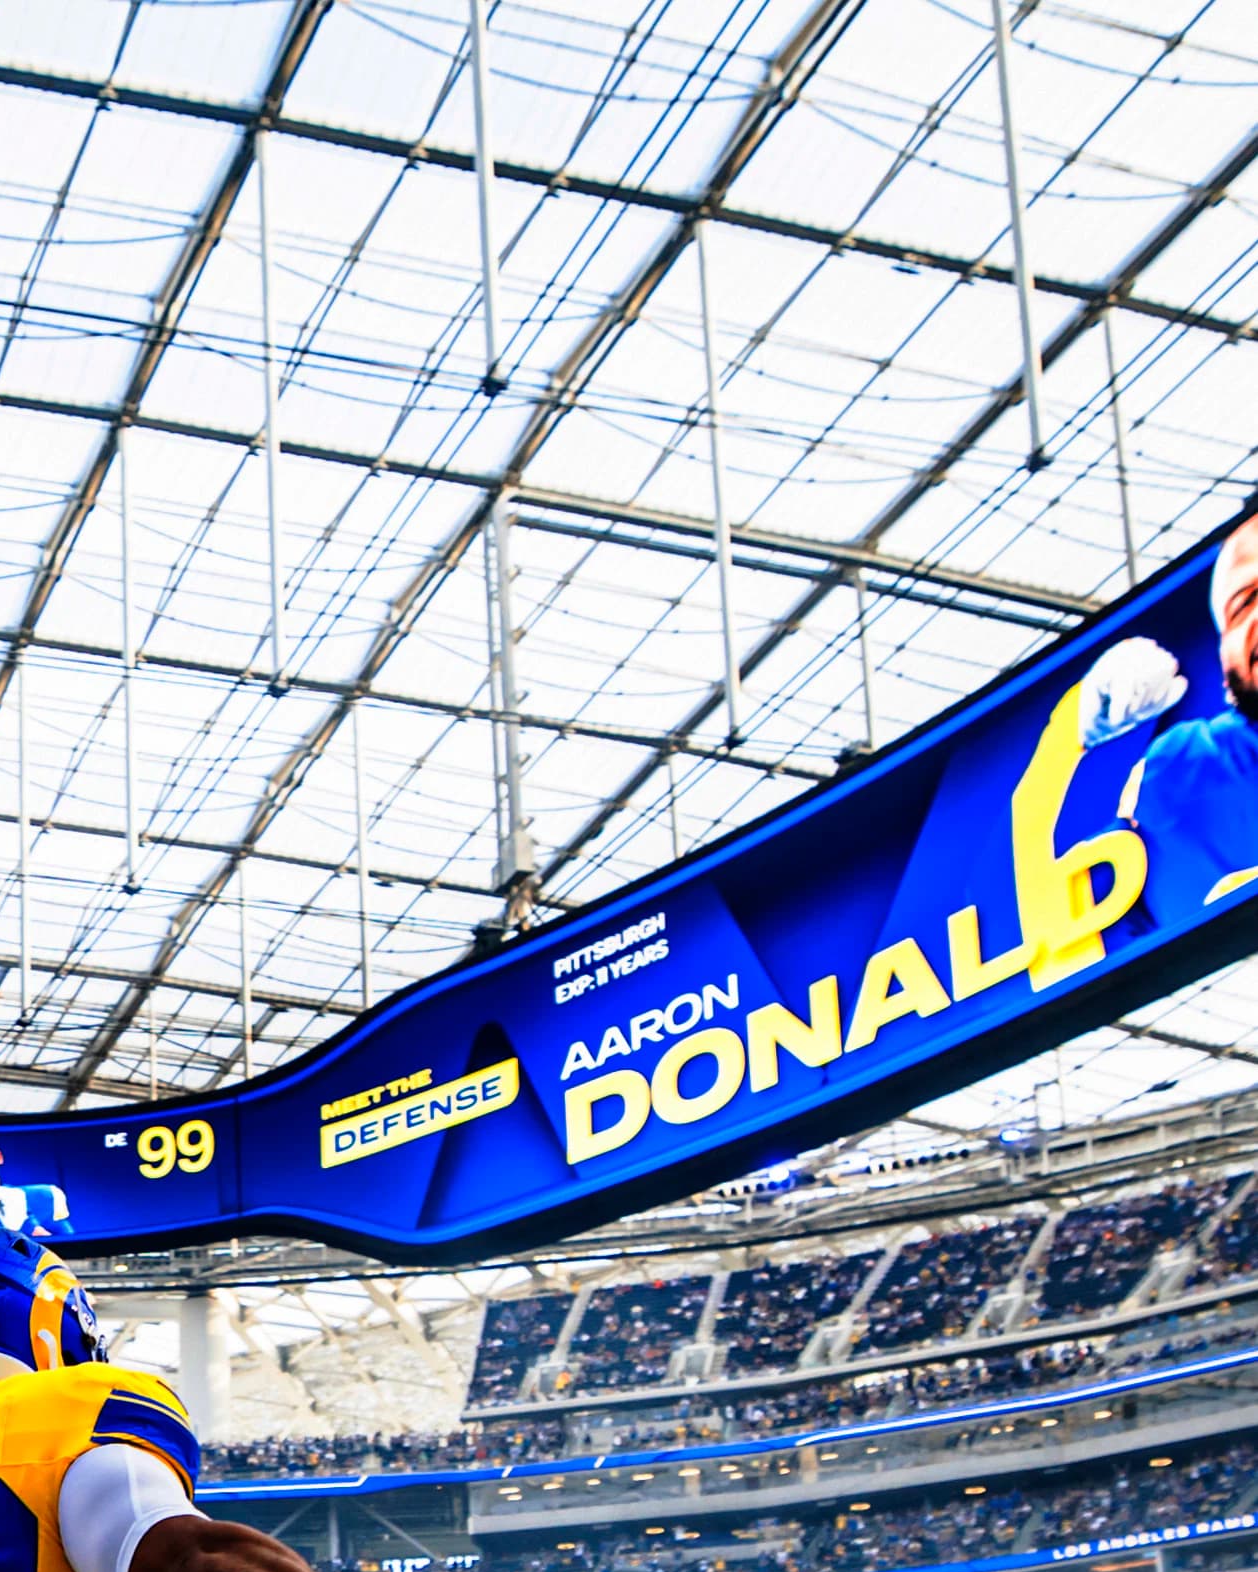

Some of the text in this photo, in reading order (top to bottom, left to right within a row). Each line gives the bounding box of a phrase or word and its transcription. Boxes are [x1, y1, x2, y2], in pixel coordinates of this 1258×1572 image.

[554, 912, 666, 979] PITTSBURGH
[555, 974, 595, 1004] EXP:
[609, 938, 669, 979] YEARS
[560, 973, 740, 1080] AARON
[564, 829, 1148, 1165] DONALD
[320, 1068, 432, 1120] MEET THE
[334, 1075, 502, 1153] DEFENSE
[137, 1119, 215, 1179] 99
[1053, 1543, 1091, 1561] LOS
[1097, 1525, 1190, 1552] ANGELES
